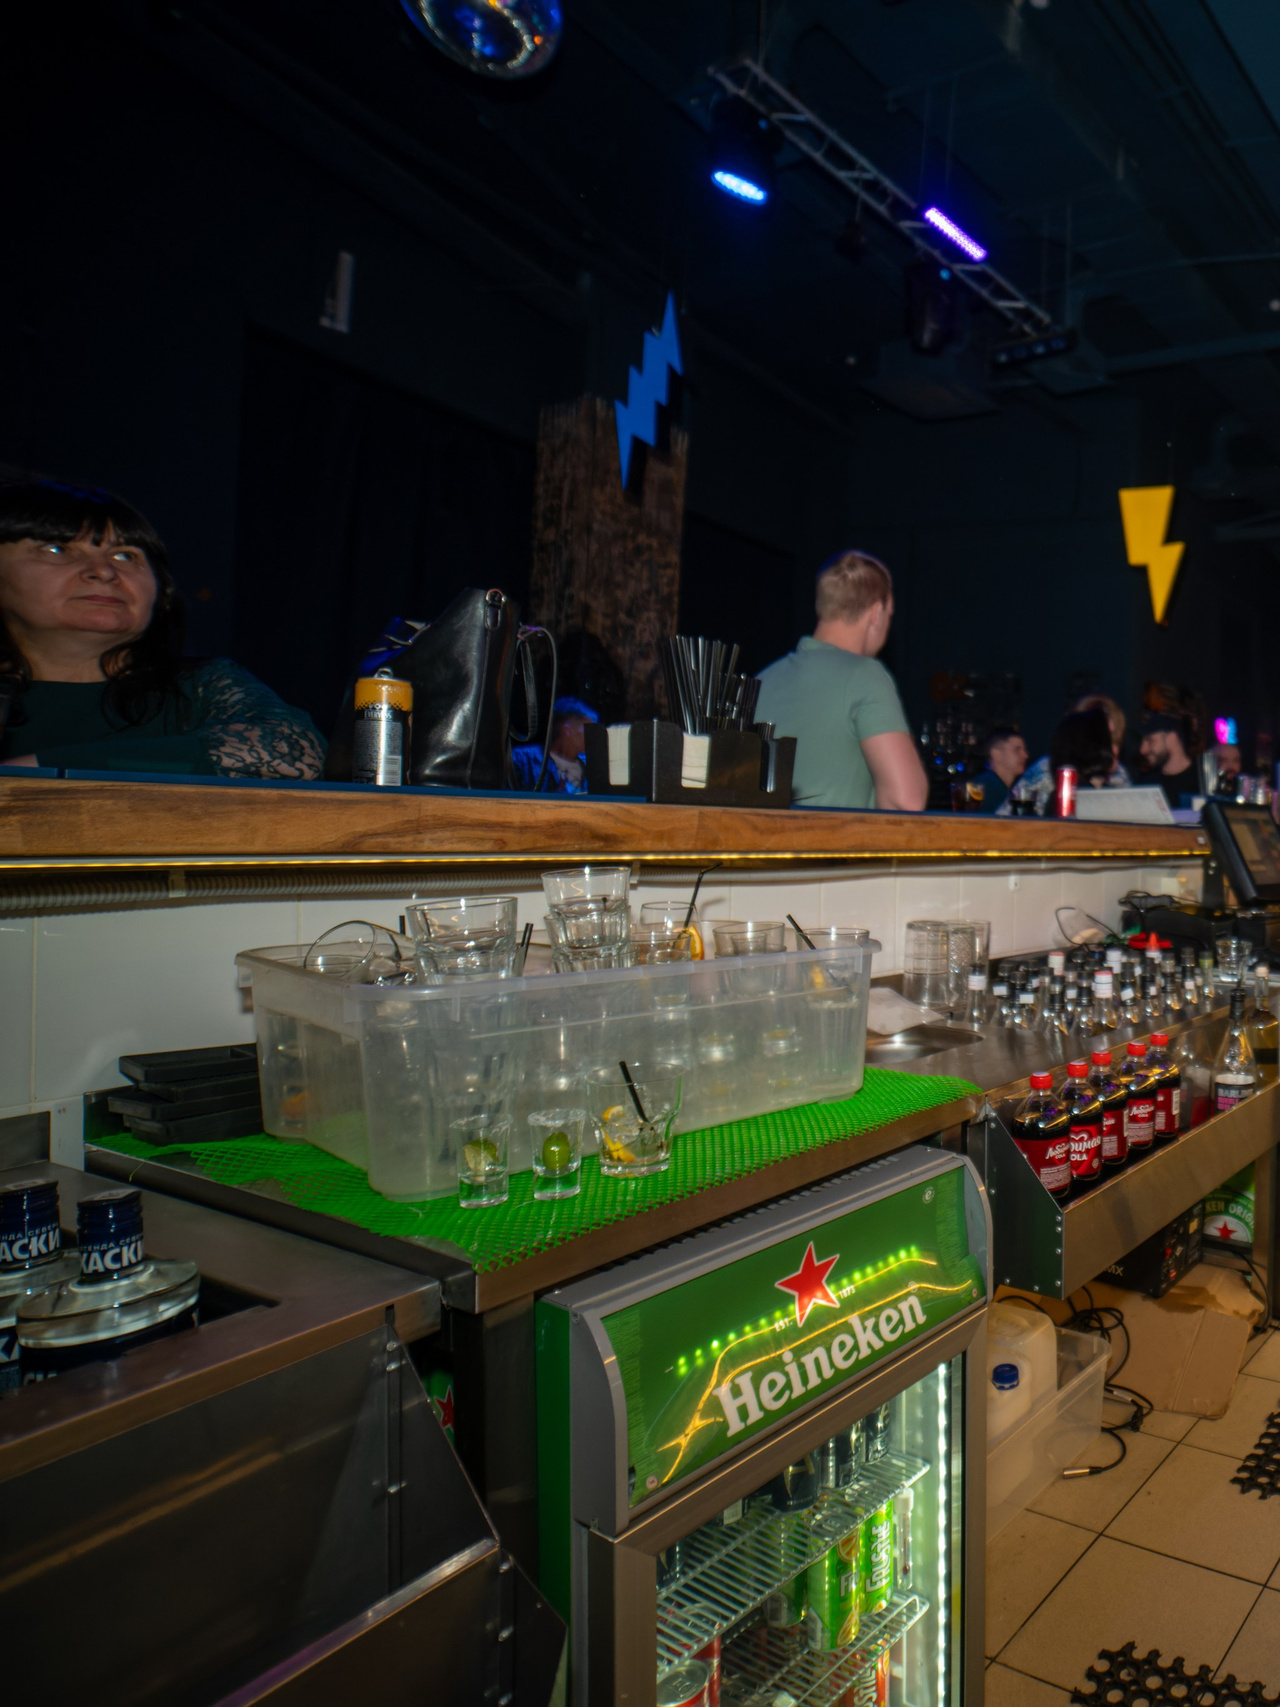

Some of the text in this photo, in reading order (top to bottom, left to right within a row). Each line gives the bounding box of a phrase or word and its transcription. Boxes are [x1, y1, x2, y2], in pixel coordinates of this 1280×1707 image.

[1070, 1153, 1088, 1161] OLA
[839, 1285, 857, 1300] 1873
[712, 1294, 927, 1438] Heineken
